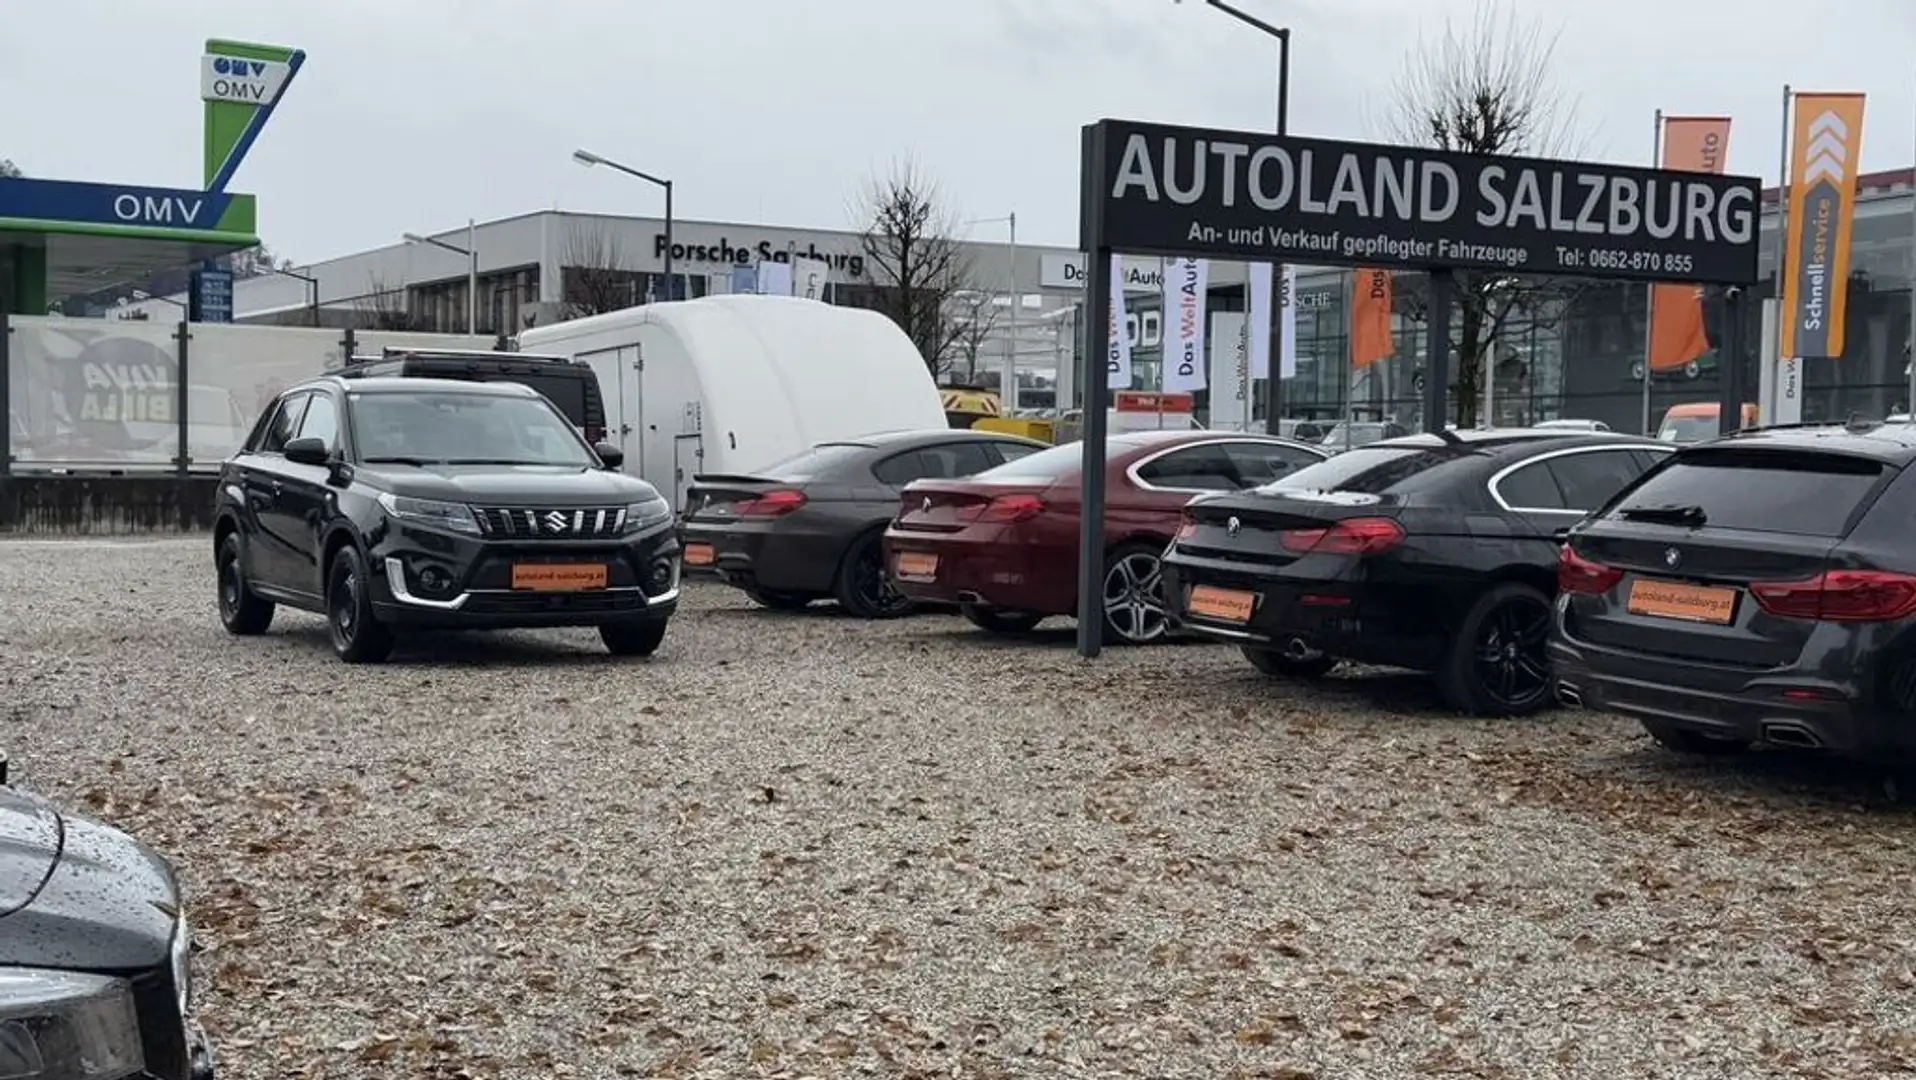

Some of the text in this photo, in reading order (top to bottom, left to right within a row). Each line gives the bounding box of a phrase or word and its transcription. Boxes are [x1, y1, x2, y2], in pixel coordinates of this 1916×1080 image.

[213, 80, 265, 99] OMV
[1112, 134, 1752, 244] AUTOLAND SALZBURG
[114, 195, 202, 224] OMV
[654, 234, 749, 262] Porsche
[1188, 221, 1527, 266] An- und Verkauf gepflegter Fahrzeuge
[1556, 246, 1693, 273] Tel: 0662-870 855
[1804, 198, 1831, 330] Schnellservice
[1178, 342, 1194, 376] Das
